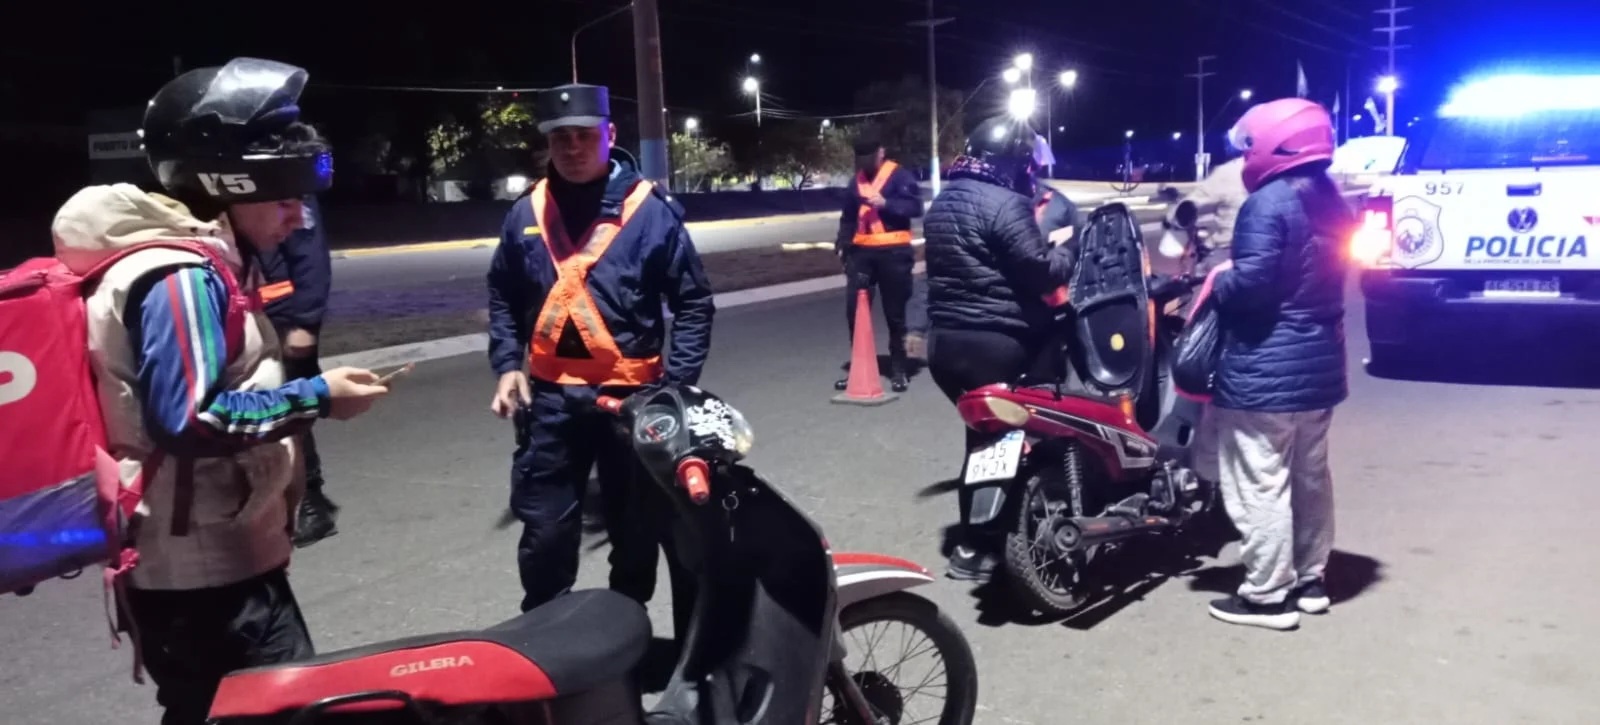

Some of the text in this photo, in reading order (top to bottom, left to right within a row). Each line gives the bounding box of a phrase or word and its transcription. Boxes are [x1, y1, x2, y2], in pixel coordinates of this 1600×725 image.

[1425, 181, 1465, 195] 957
[1465, 235, 1587, 258] POLICIA
[389, 655, 475, 677] GILERA
